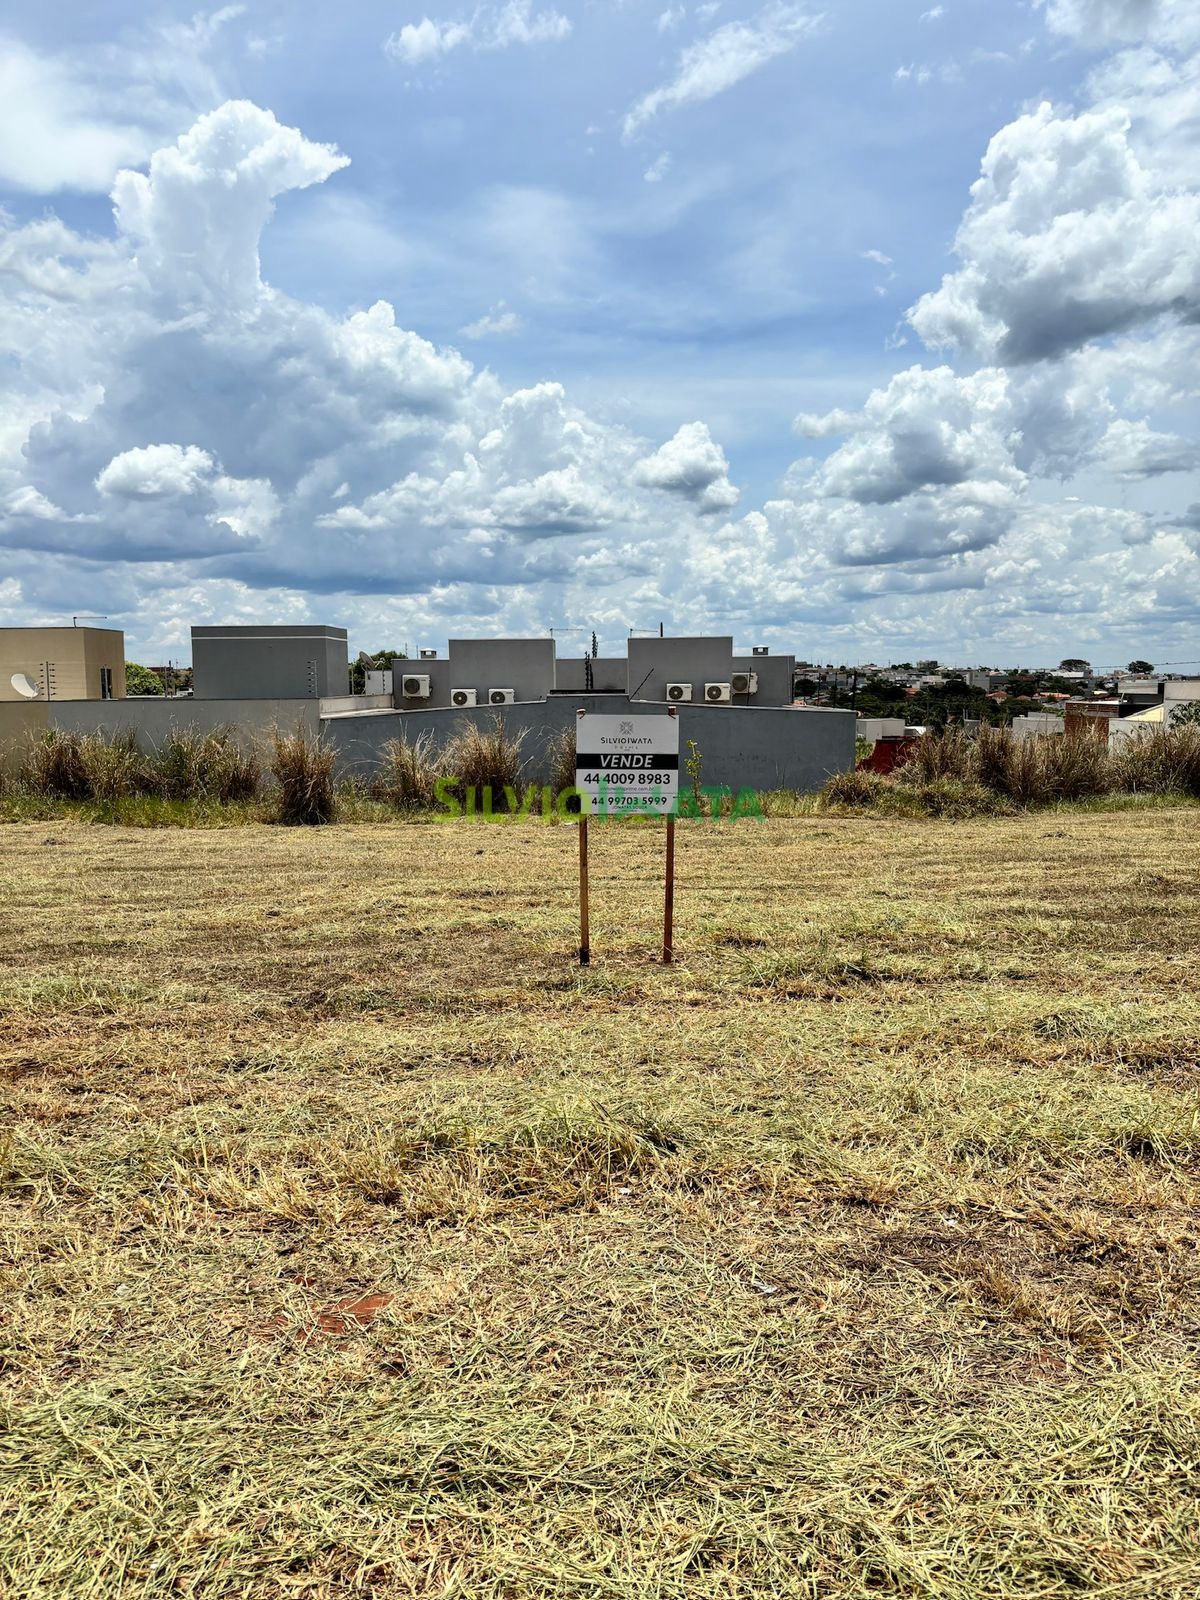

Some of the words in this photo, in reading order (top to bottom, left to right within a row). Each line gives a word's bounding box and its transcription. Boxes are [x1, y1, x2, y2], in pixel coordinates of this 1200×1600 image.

[600, 755, 654, 768] VENDE
[584, 773, 600, 784] 44
[602, 773, 635, 784] 4009
[638, 773, 671, 784] 8983
[591, 797, 605, 805] 44
[608, 797, 639, 805] 99703
[642, 797, 667, 805] 5999
